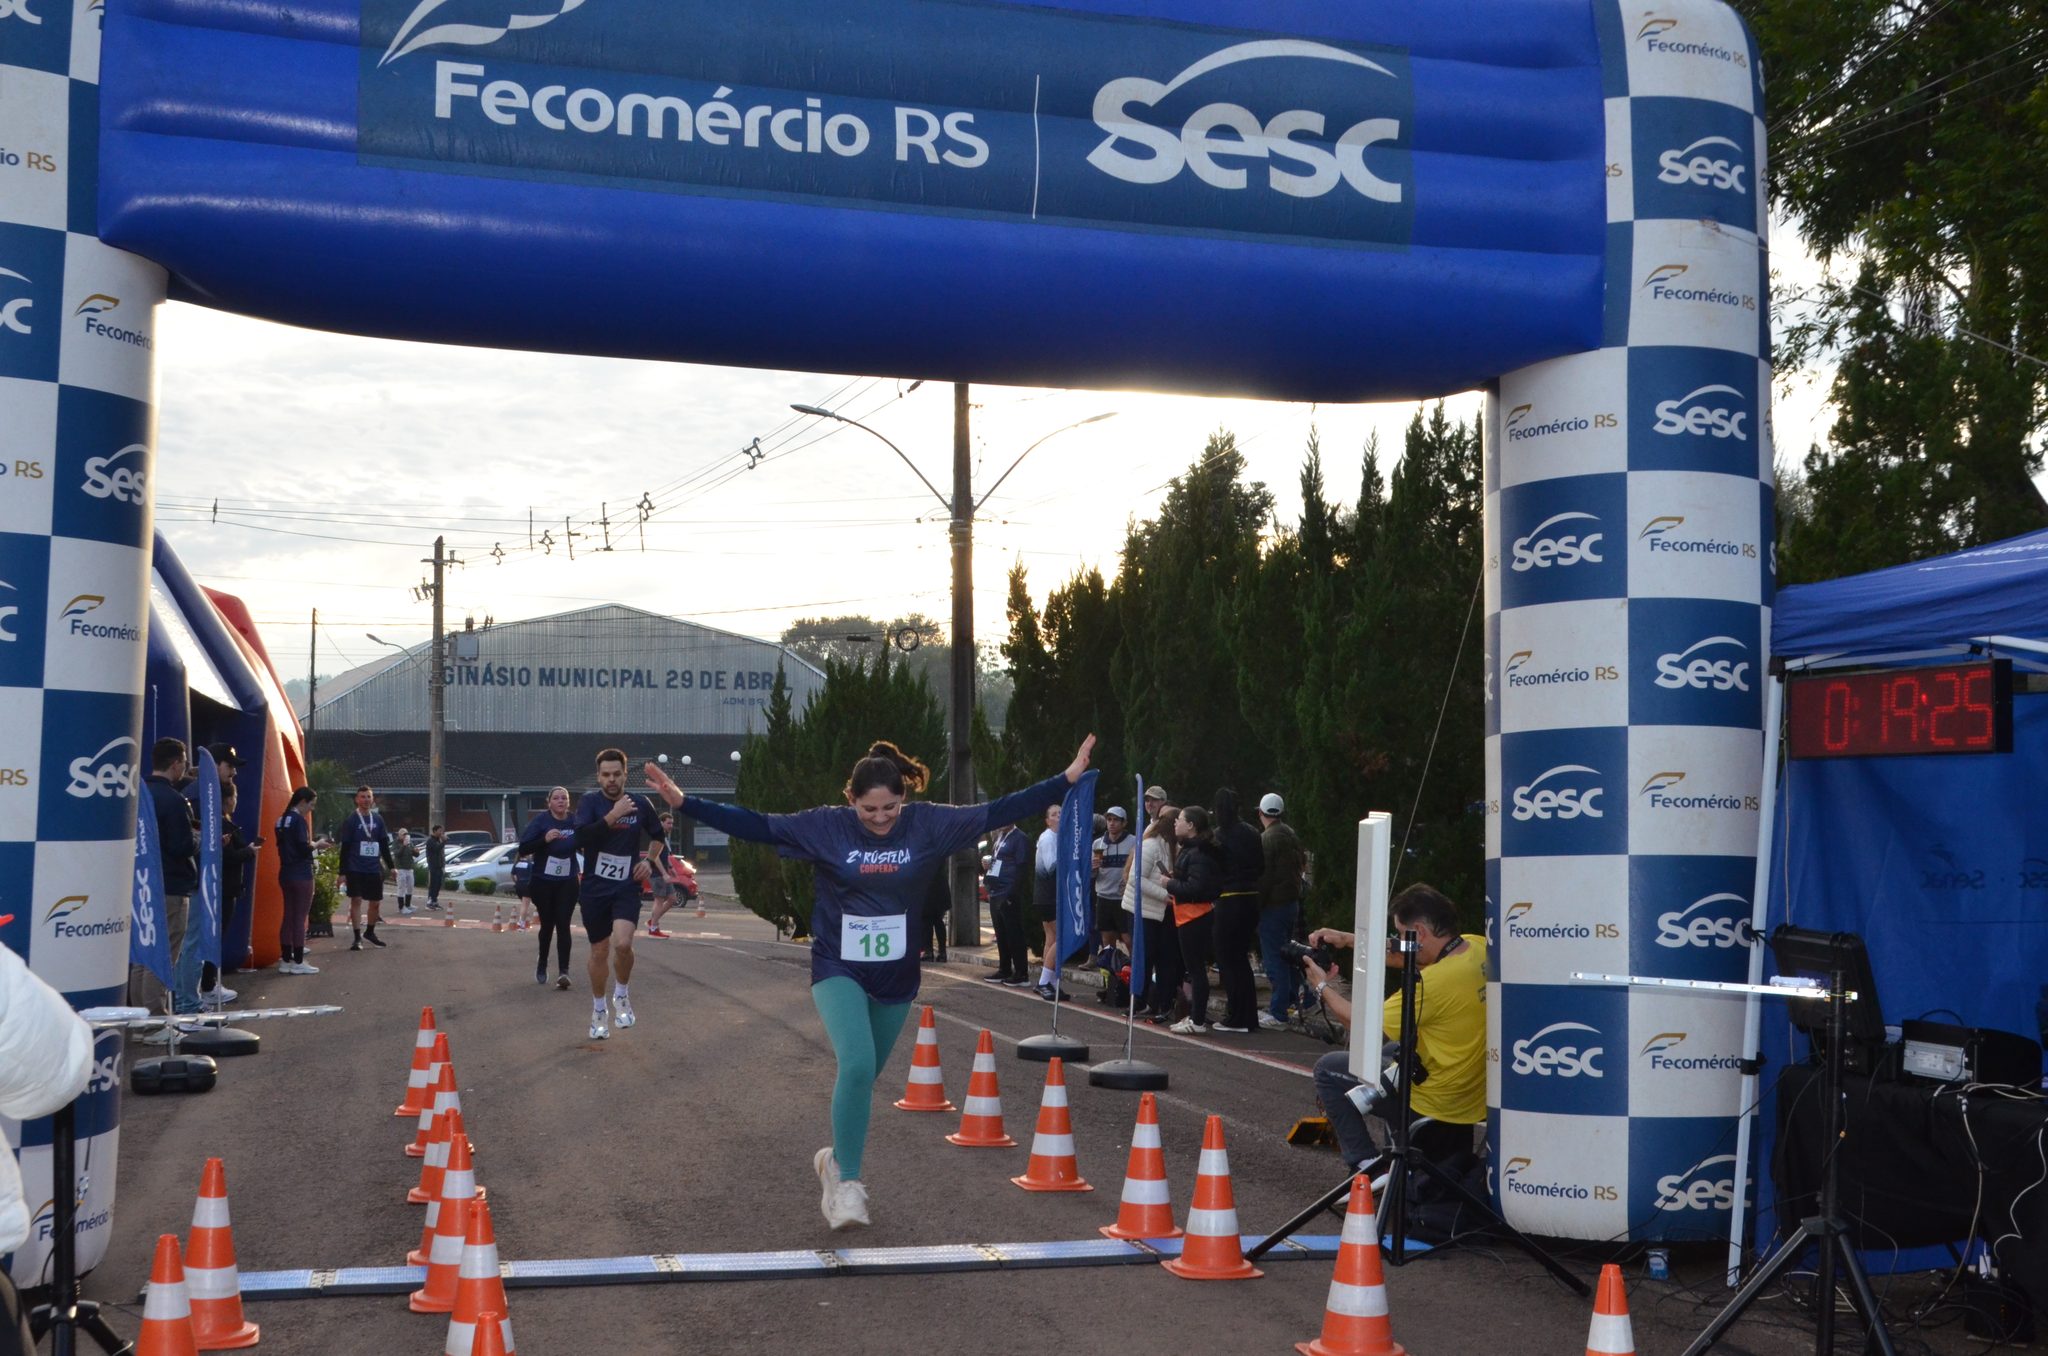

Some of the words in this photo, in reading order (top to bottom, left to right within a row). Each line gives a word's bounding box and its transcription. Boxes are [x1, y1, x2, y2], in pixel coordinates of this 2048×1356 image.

[1648, 39, 1731, 61] Fecomércio
[1734, 51, 1747, 68] RS
[434, 60, 870, 157] Fecomércio
[894, 106, 990, 168] RS
[1086, 39, 1402, 203] Sesc
[27, 152, 56, 172] RS
[1657, 136, 1746, 194] Sesc
[1654, 286, 1739, 306] Fecomércio
[1742, 294, 1755, 311] RS
[1653, 384, 1747, 441] Sesc
[1509, 419, 1588, 442] Fecomércio
[1594, 413, 1618, 428] RS
[15, 460, 43, 478] RS
[1511, 511, 1603, 572] Sesc
[1650, 538, 1739, 556] Fecomércio
[1742, 543, 1756, 558] RS
[441, 662, 531, 687] GINÁSIO
[538, 667, 659, 689] MUNICIPAL
[666, 670, 694, 689] 29
[701, 670, 726, 690] DE
[733, 671, 793, 691] ABRL
[1510, 668, 1589, 688] Fecomércio
[1595, 666, 1619, 681] RS
[1654, 635, 1749, 692] Sesc
[1512, 764, 1603, 821] Sesc
[1651, 794, 1741, 809] Fecomércio
[1744, 796, 1759, 812] RS
[556, 866, 562, 875] 8
[601, 862, 625, 879] 721
[131, 868, 156, 947] Sesc
[1655, 892, 1752, 948] Sesc
[55, 918, 124, 938] Fecomércio
[1510, 923, 1589, 939] Fecomércio
[1595, 924, 1620, 939] RS
[859, 933, 890, 957] 18
[1511, 1021, 1603, 1078] Sesc
[1651, 1054, 1742, 1070] Fecomércio
[1509, 1178, 1588, 1199] Fecomércio
[1594, 1185, 1618, 1201] RS
